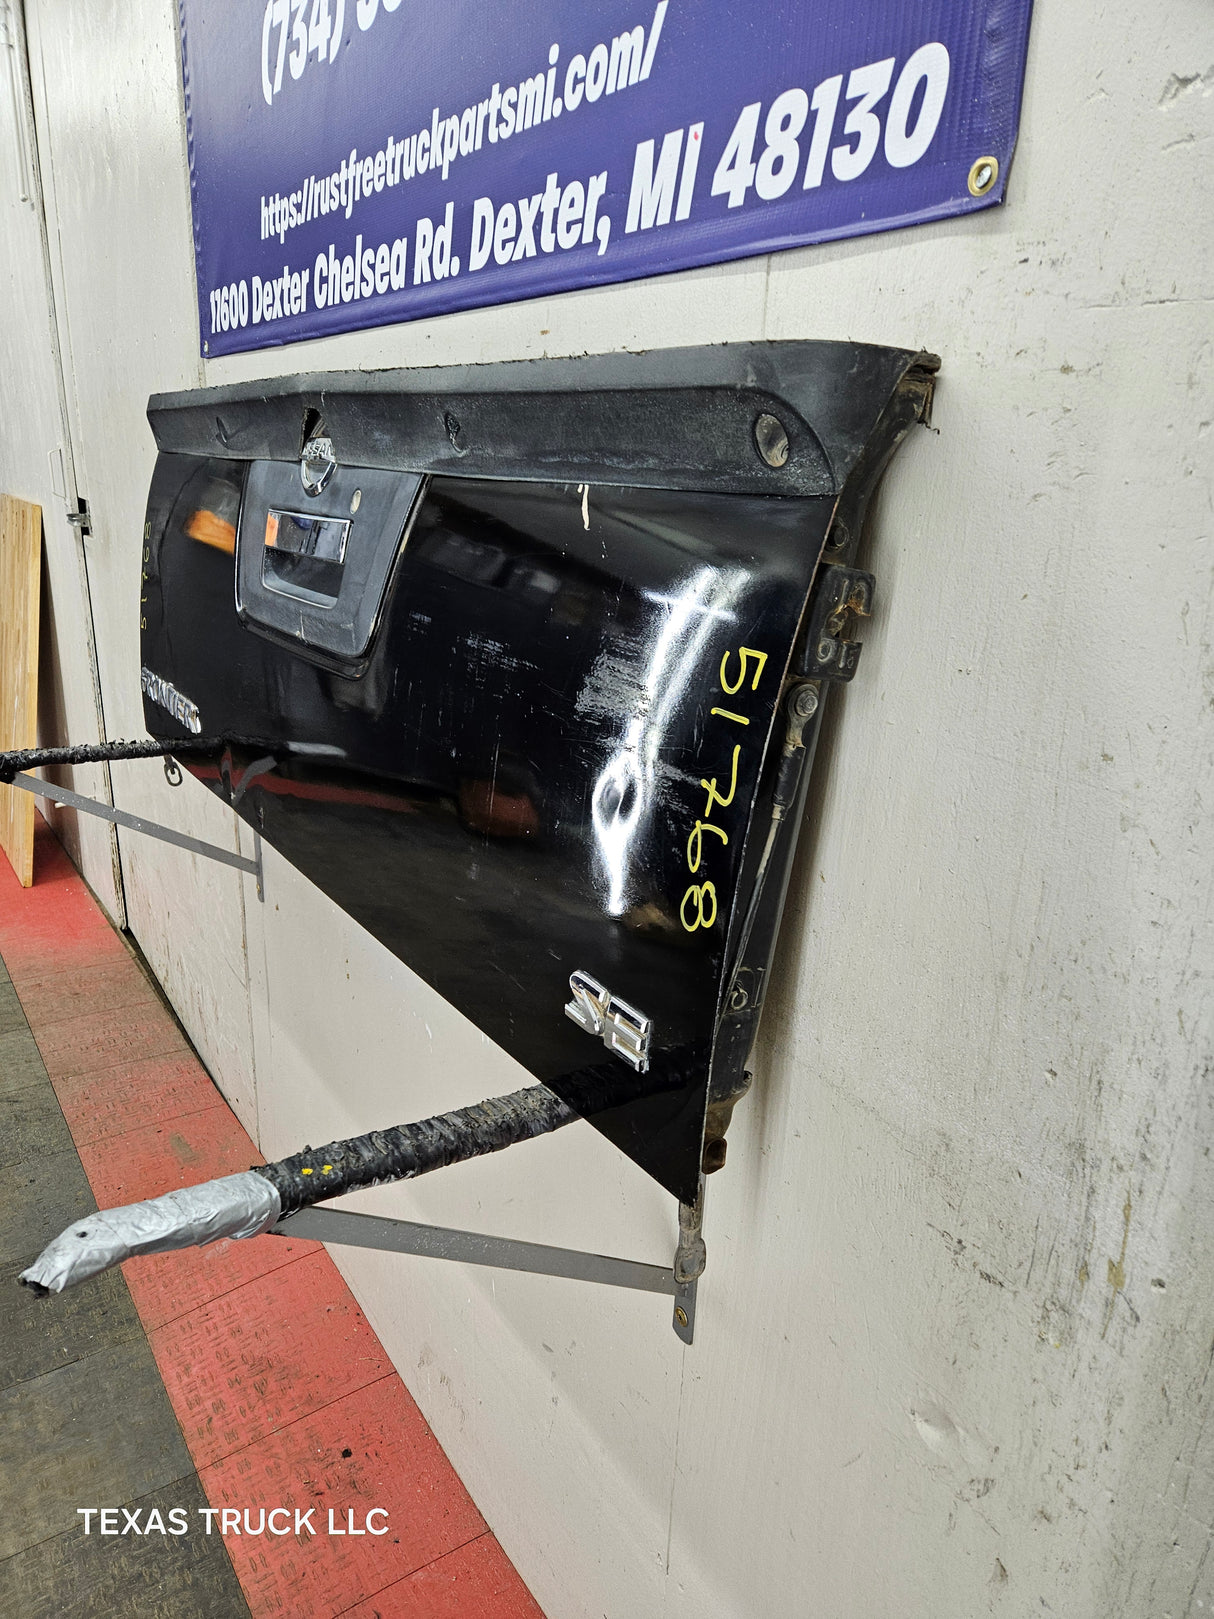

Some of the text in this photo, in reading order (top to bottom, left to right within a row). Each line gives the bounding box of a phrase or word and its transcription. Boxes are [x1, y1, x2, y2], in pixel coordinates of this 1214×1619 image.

[209, 42, 950, 334] 11600 Dexter Chelsea Rd. Dexter, MI 48130
[260, 0, 669, 244] https://rustfreetruckpartsmi.com/
[679, 646, 768, 932] 51768
[564, 969, 653, 1074] SE
